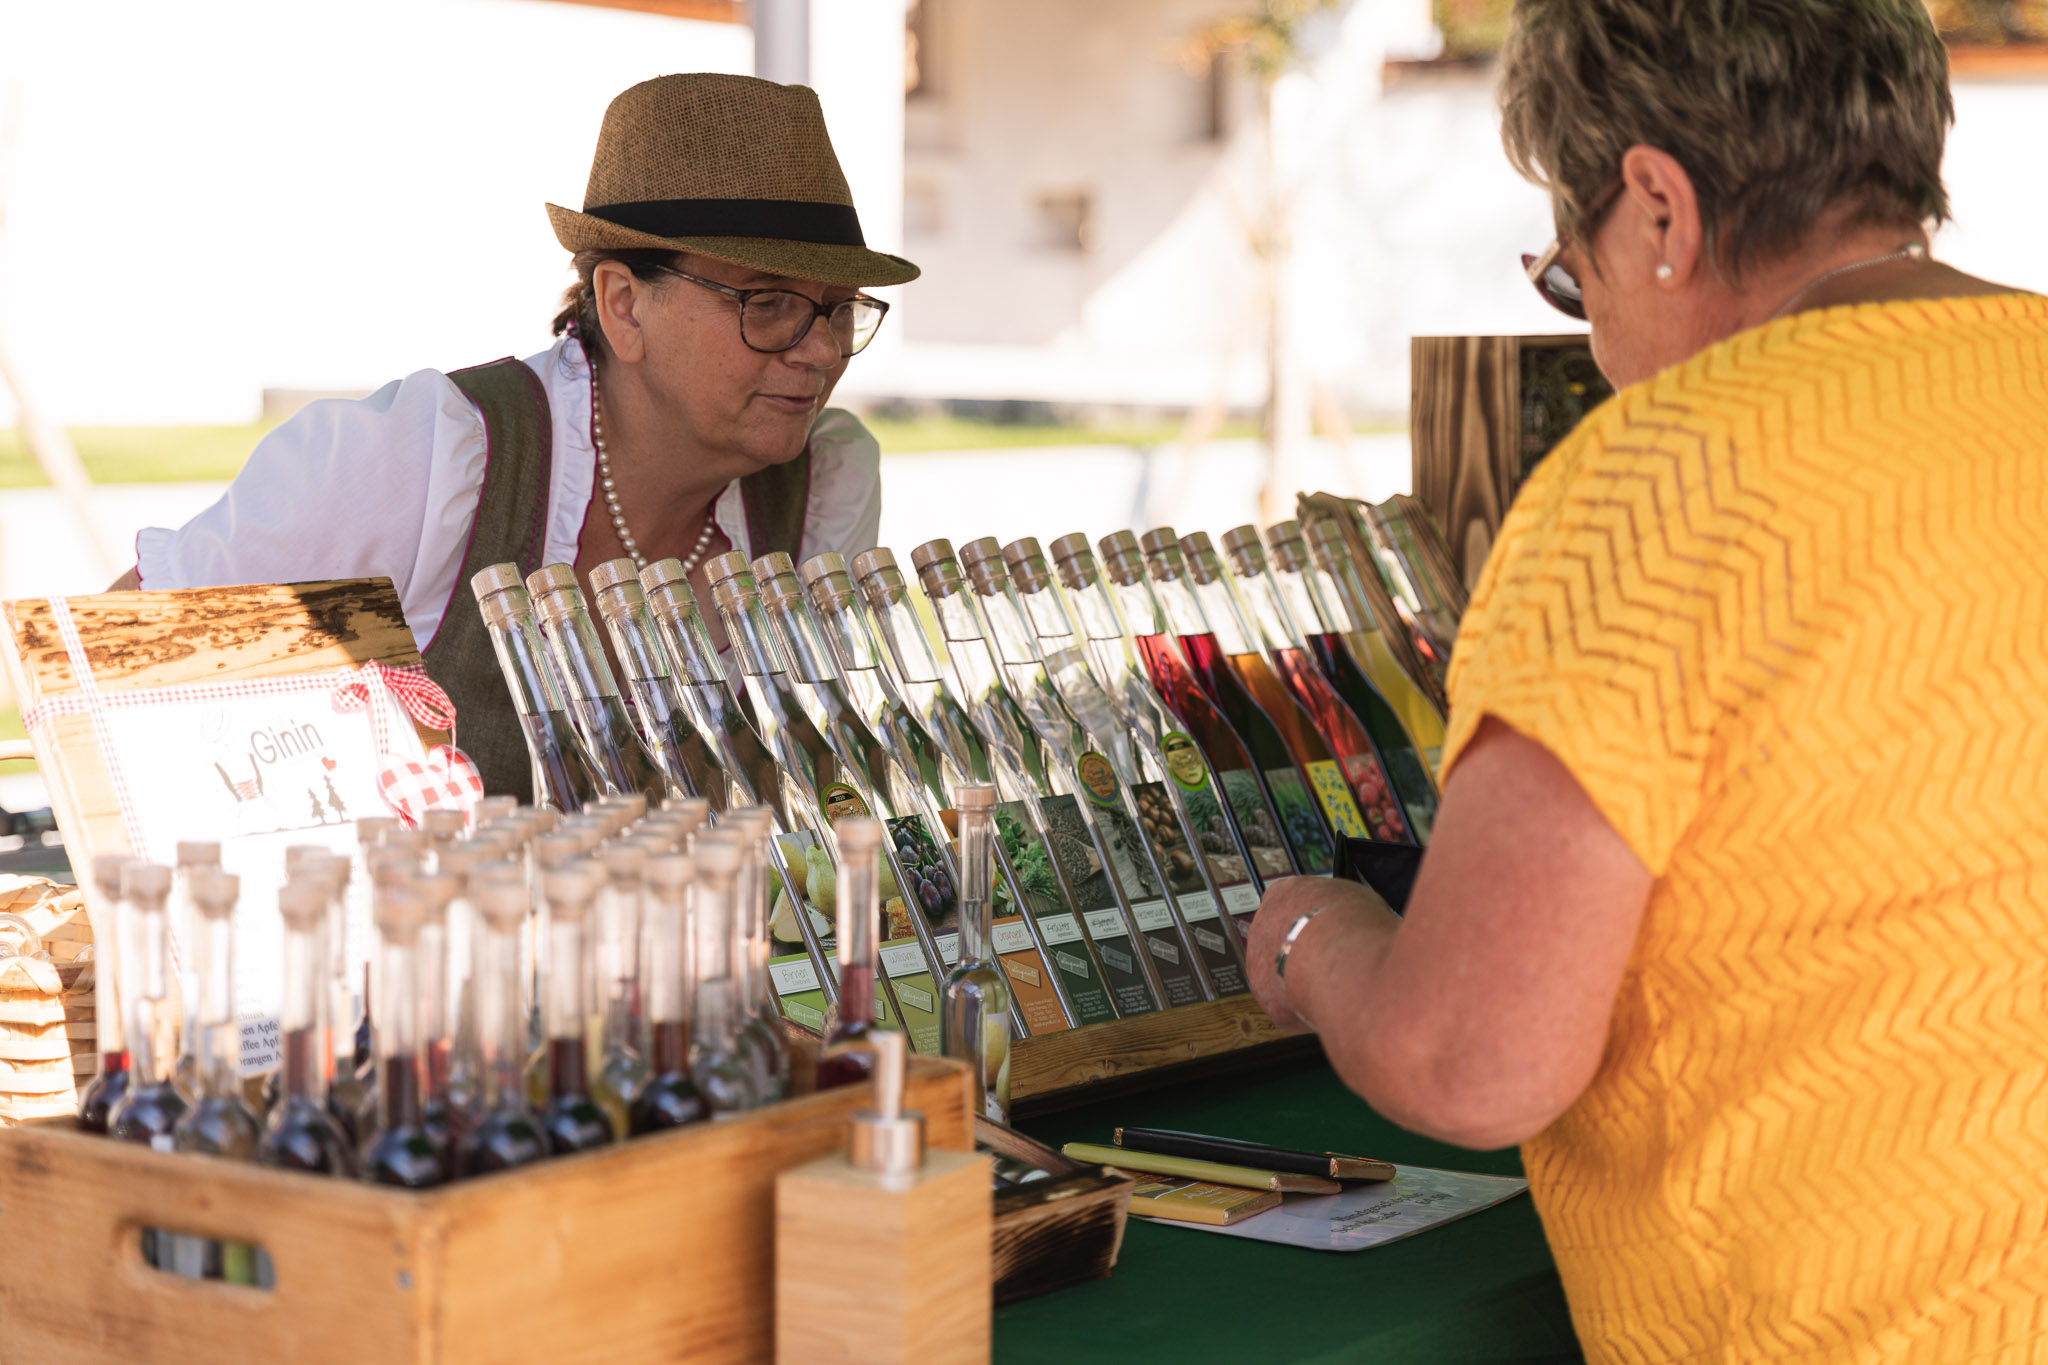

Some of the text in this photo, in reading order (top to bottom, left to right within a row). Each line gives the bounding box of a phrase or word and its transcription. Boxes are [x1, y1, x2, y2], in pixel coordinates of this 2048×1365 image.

[250, 718, 325, 765] Ginin
[937, 938, 959, 954] Zwet
[781, 968, 809, 983] Birnen
[240, 1053, 273, 1067] rangen
